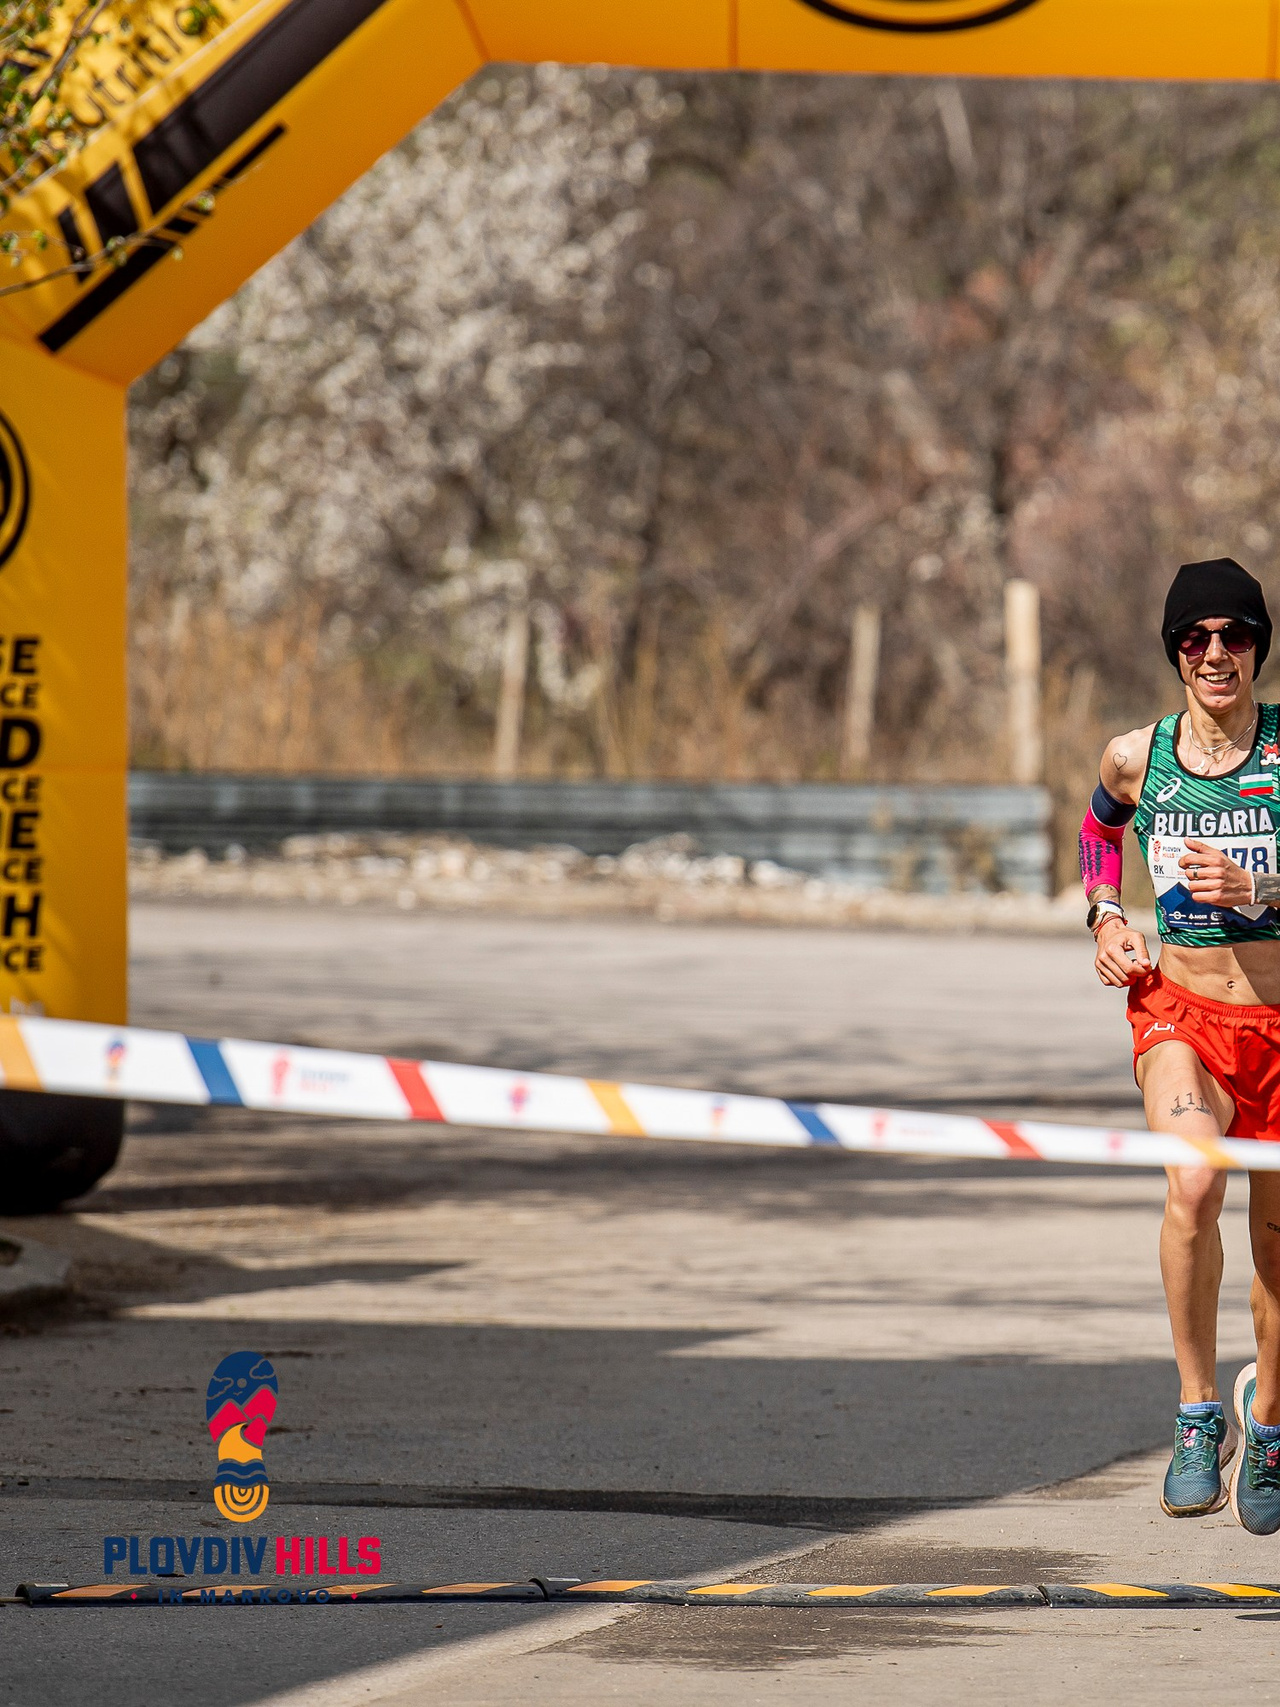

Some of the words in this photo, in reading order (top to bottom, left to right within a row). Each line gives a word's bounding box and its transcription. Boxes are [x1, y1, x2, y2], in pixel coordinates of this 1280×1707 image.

[0, 637, 38, 673] E
[1154, 807, 1274, 836] BULGARIA
[1153, 864, 1164, 875] 8K
